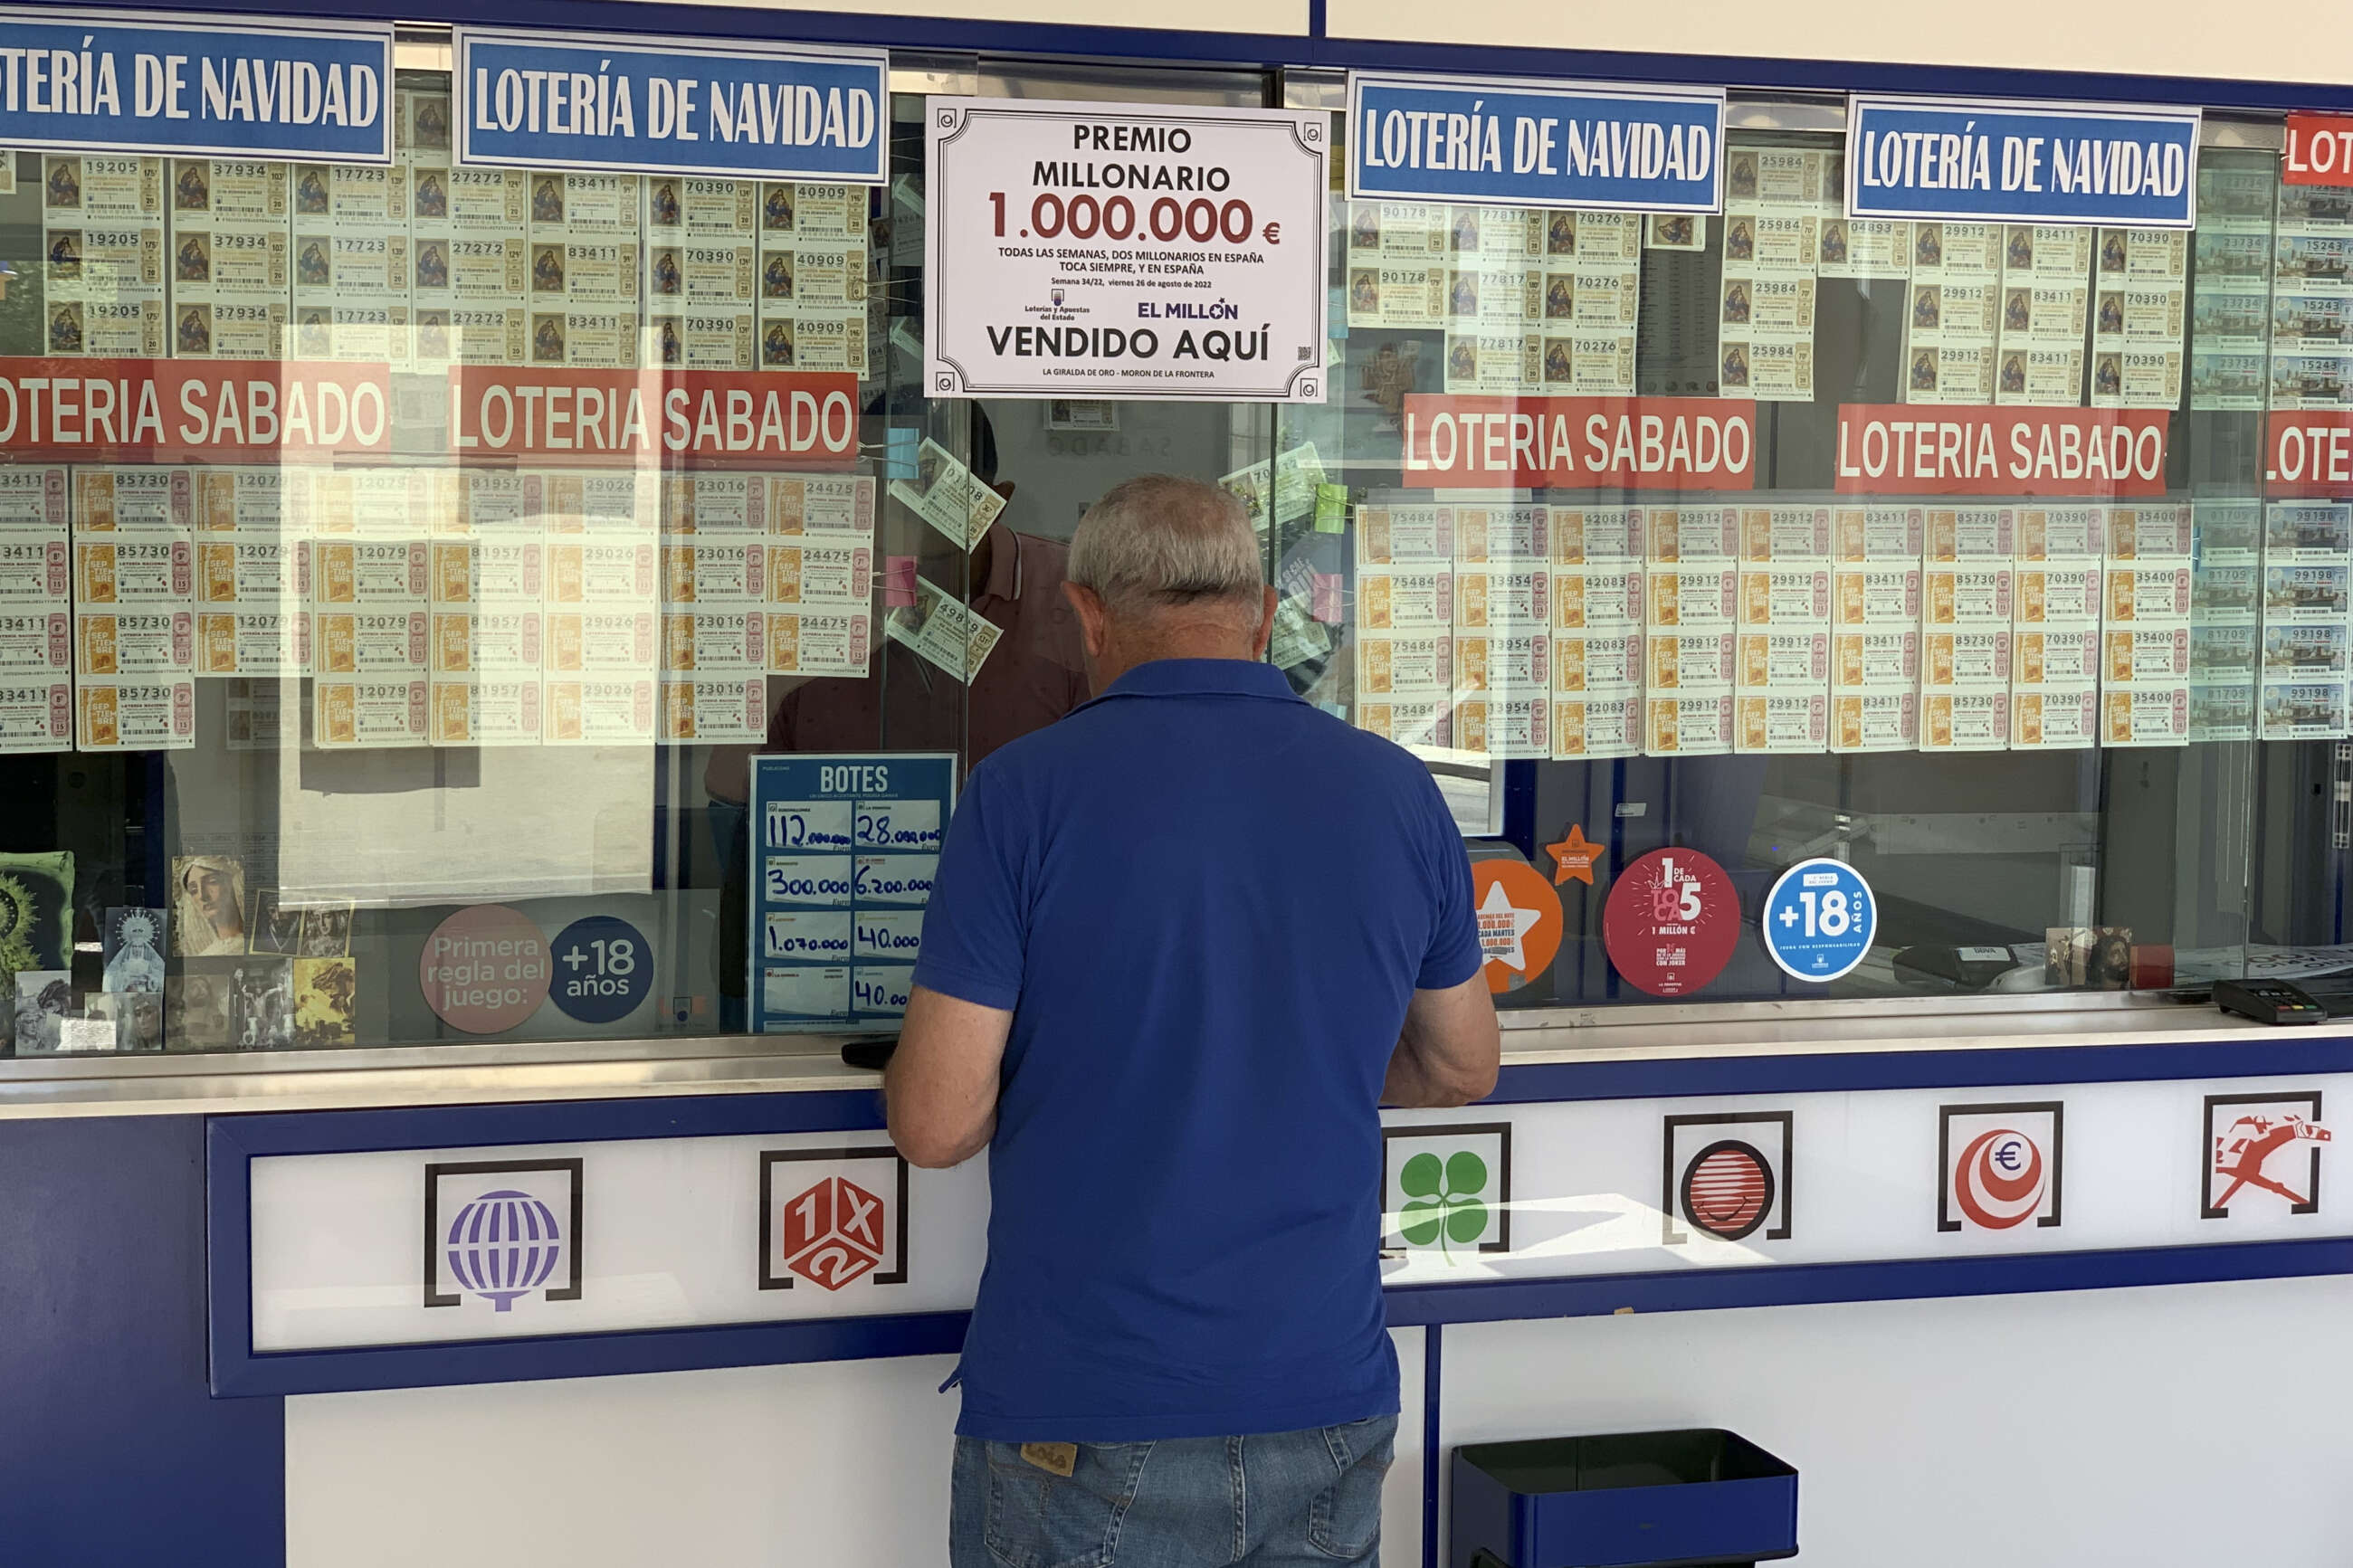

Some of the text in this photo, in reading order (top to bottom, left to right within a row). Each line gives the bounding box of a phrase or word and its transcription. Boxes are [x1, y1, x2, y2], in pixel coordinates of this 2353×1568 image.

[0, 35, 379, 128] TERÍA DE NAVIDAD
[477, 60, 875, 148] LOTERÍA DE NAVIDAD
[1074, 124, 1192, 153] PREMIO
[1366, 100, 1711, 182] LOTERÍA DE NAVIDAD
[1761, 157, 1803, 167] 25984
[1863, 121, 2185, 197] LOTERÍA DE NAVIDAD
[87, 161, 138, 172] 19205
[214, 165, 267, 176] 37934
[335, 169, 385, 180] 17723
[452, 173, 501, 184] 27272
[1033, 161, 1230, 192] MILLONARIO
[568, 177, 616, 189] 83411
[687, 182, 734, 193] 70390
[798, 186, 845, 197] 40909
[989, 192, 1281, 244] 1.000.000 €
[1579, 214, 1621, 224] 70276
[1759, 220, 1800, 231] 25984
[1851, 223, 1892, 233] 04893
[1946, 226, 1985, 236] 29912
[2036, 229, 2074, 240] 83411
[2129, 233, 2169, 243] 70390
[2307, 241, 2343, 251] 15243
[998, 247, 1264, 263] TODAS LAS SEMANAS, DOS MILLONARIOS EN ESPAÑA
[1060, 261, 1205, 275] TOCA SIEMPRE, Y EN ESPAÑA
[1382, 271, 1425, 283] 90178
[1481, 274, 1524, 285] 77817
[1577, 276, 1619, 288] 70276
[1051, 277, 1080, 285] Semana
[1081, 278, 1105, 287] 34/22,
[1109, 279, 1135, 287] viernes
[1147, 280, 1156, 288] de
[1157, 280, 1182, 290] agosto
[1194, 280, 1212, 289] 2022
[90, 306, 139, 317] 19205
[214, 307, 267, 318] 37934
[337, 310, 386, 322] 17723
[1059, 306, 1091, 314] Apuestas
[1138, 302, 1161, 318] EL
[453, 313, 503, 324] 27272
[568, 316, 616, 328] 83411
[687, 319, 734, 330] 70390
[796, 322, 844, 333] 40909
[986, 323, 1271, 362] VENDIDO AQUÍ
[180, 378, 385, 446] SABADO
[453, 385, 853, 452] LOTERIA SABADO
[1406, 412, 1750, 475] LOTERIA SABADO
[1840, 421, 2162, 481] LOTERIA SABADO
[2266, 426, 2353, 480] OTE
[118, 546, 169, 557] 85730
[357, 546, 406, 559] 12079
[472, 546, 519, 559] 81957
[586, 547, 634, 559] 29026
[698, 548, 745, 559] 23016
[804, 549, 850, 562] 24475
[1393, 576, 1435, 587] 75484
[1491, 575, 1530, 586] 13954
[1586, 576, 1625, 587] 42083
[1680, 575, 1720, 585] 29912
[1772, 575, 1811, 585] 29912
[1866, 574, 1904, 584] 83411
[1957, 574, 1996, 585] 85730
[2047, 573, 2085, 584] 70390
[2137, 571, 2175, 583] 35400
[2295, 570, 2332, 581] 99198
[820, 765, 889, 793] BOTES
[1662, 858, 1673, 888] 1
[767, 869, 850, 895] 300.000
[1680, 882, 1701, 921] 5
[1779, 889, 1851, 937] +18
[1852, 891, 1862, 934] AÑOS
[1659, 925, 1688, 935] MILLÓN
[433, 936, 539, 958] Primera
[562, 938, 635, 976] +18
[427, 959, 545, 985] regla del
[567, 974, 630, 997] años
[443, 986, 528, 1011] juego:
